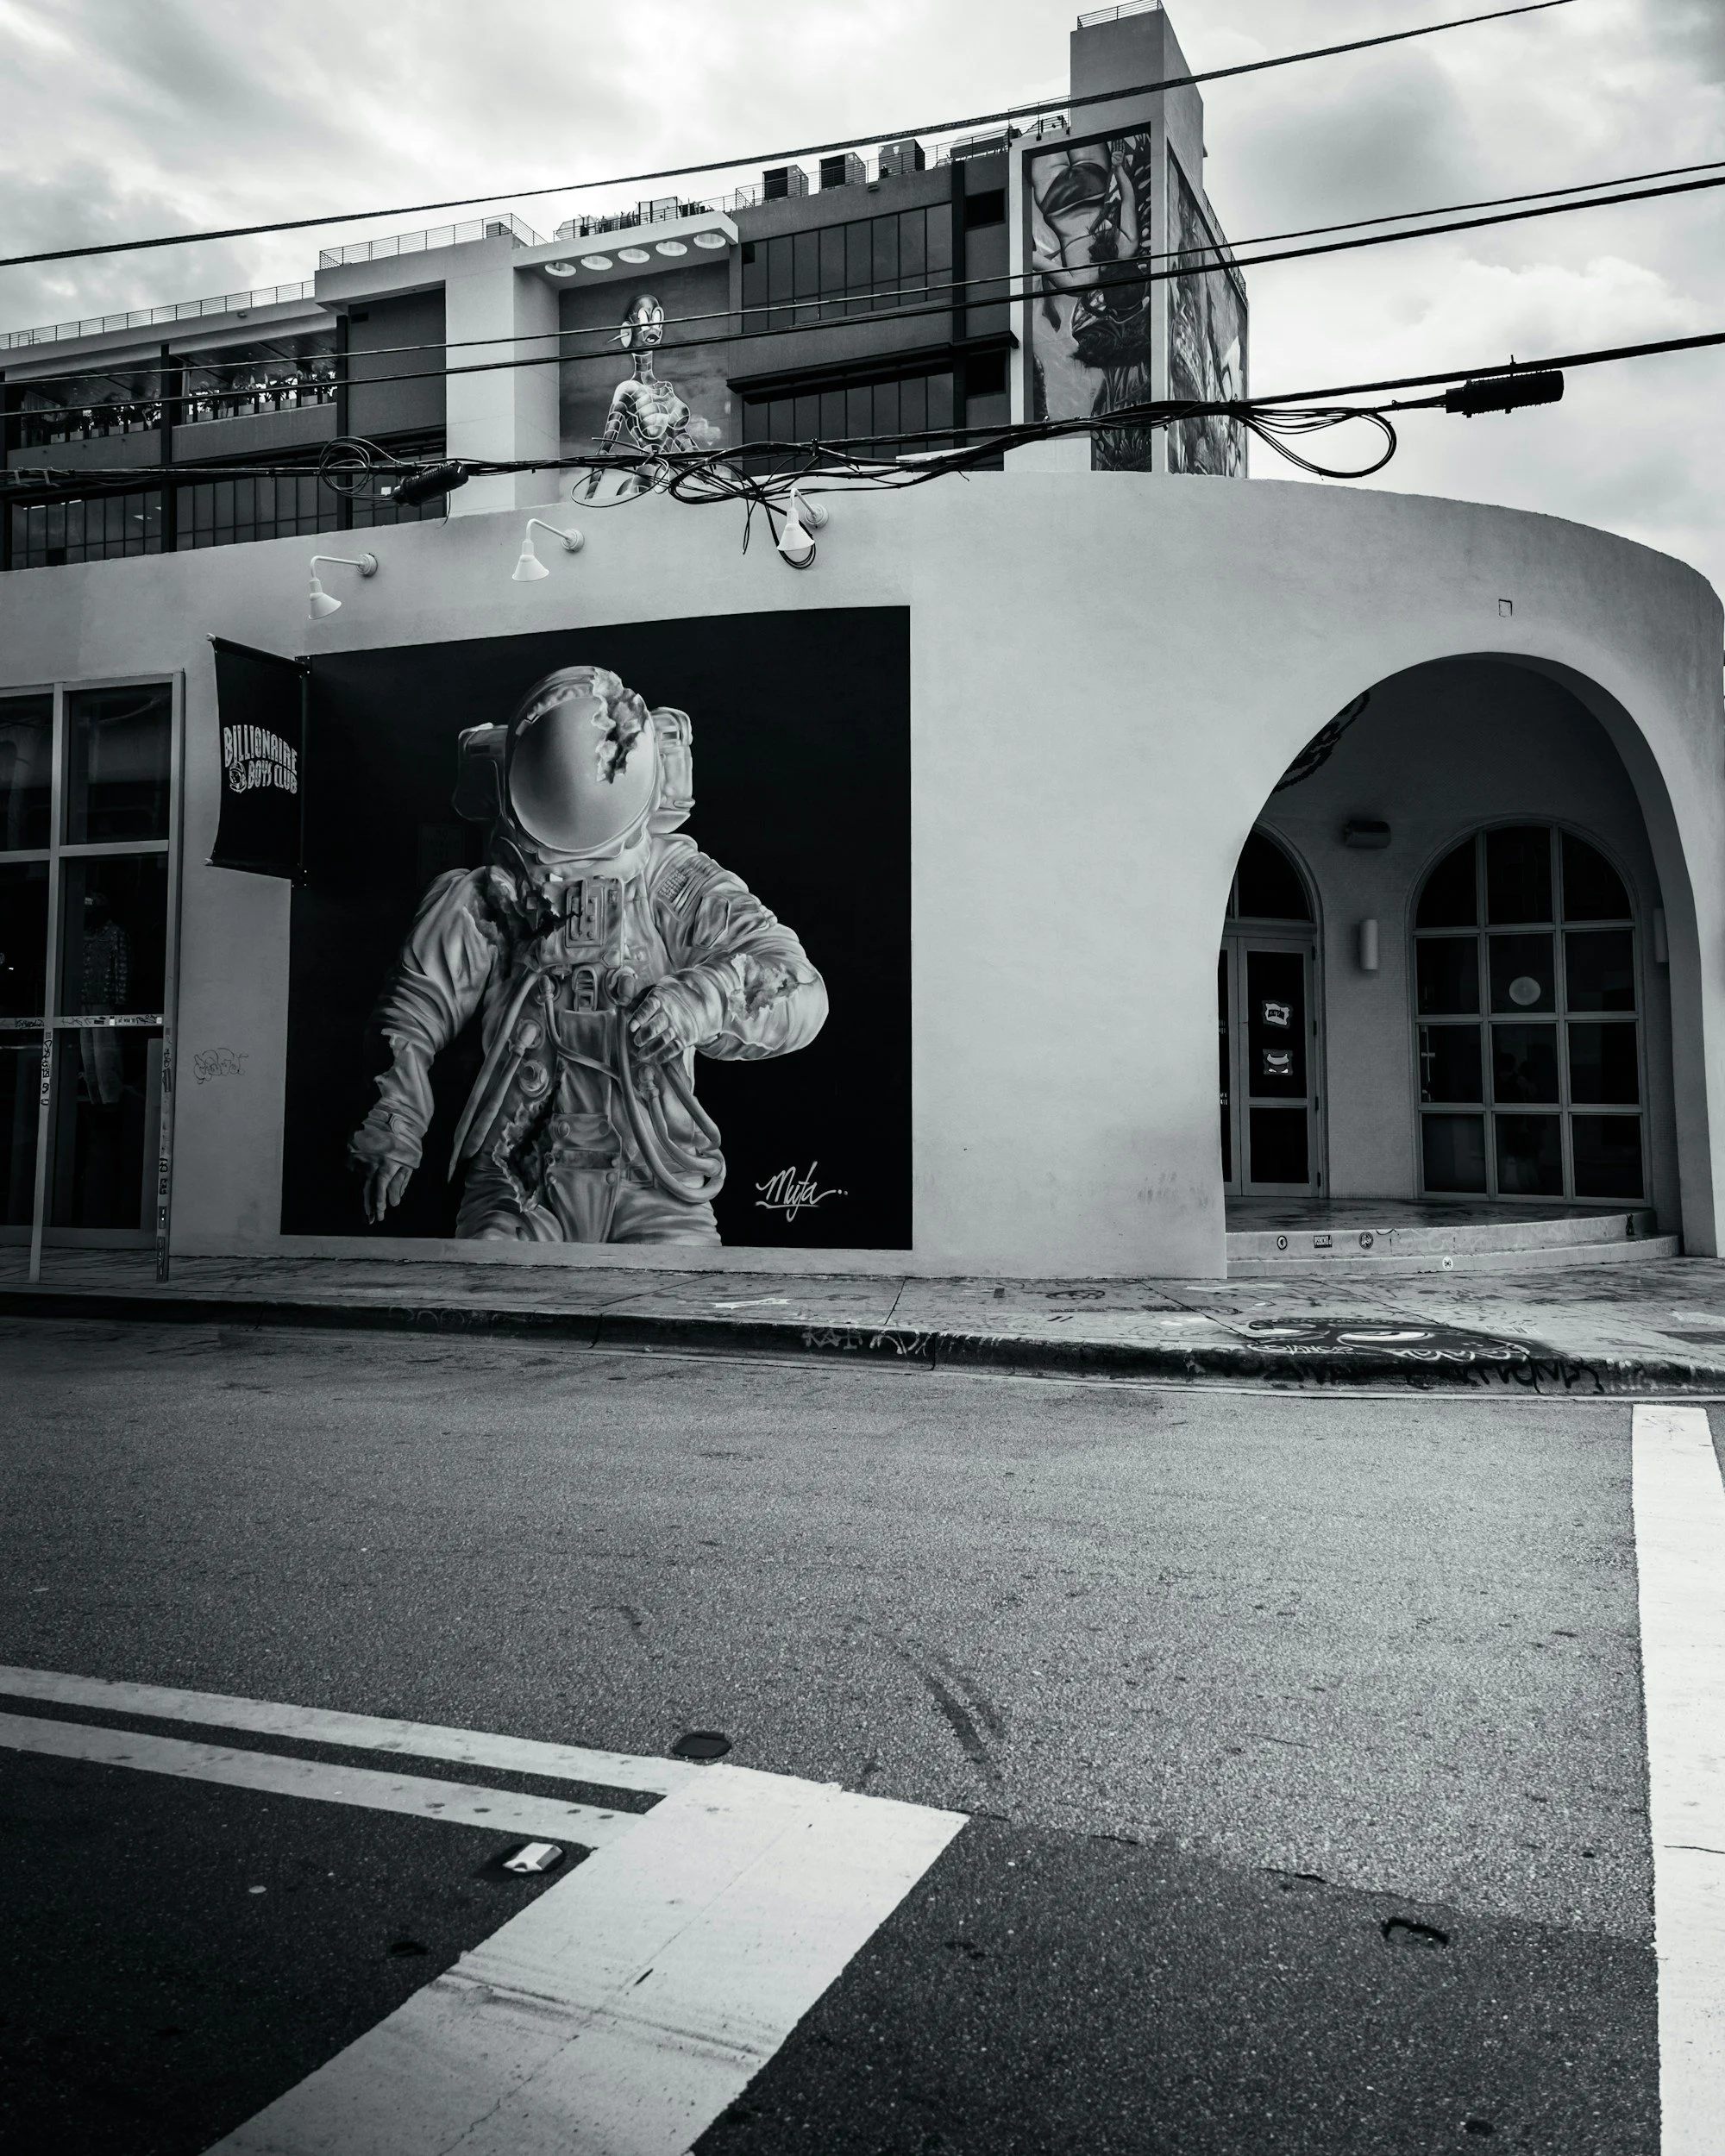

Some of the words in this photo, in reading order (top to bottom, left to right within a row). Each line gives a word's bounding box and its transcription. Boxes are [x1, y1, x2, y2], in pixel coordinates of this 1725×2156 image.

[224, 725, 298, 774] BILLIONAIRE
[248, 761, 273, 789] BOYS
[275, 765, 298, 793] CLUB
